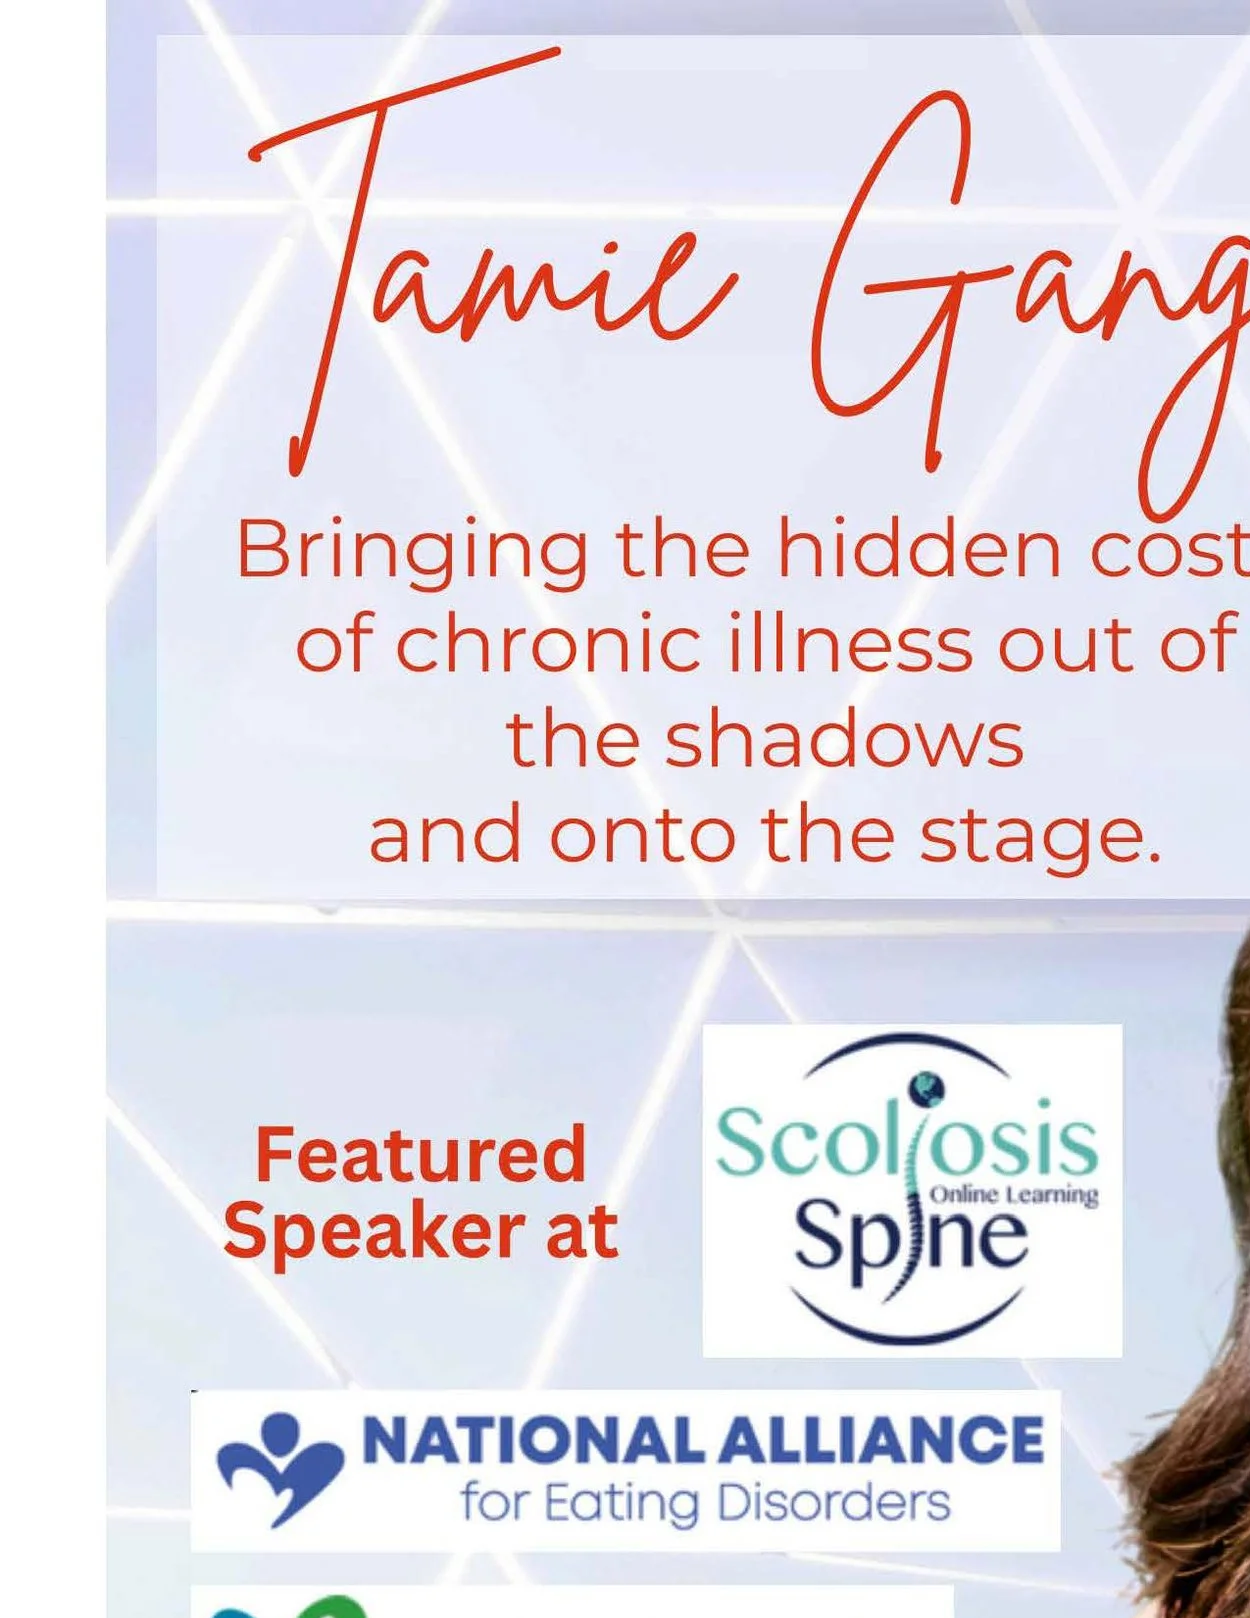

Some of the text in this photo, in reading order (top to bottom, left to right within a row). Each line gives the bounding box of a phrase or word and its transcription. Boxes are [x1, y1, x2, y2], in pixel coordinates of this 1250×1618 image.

[248, 47, 739, 477] Tamie
[240, 515, 586, 593] Bringing
[616, 516, 749, 577] the
[781, 516, 1059, 577] hidden
[297, 610, 1238, 672] of chronic illness out of
[506, 706, 1023, 768] the shadows
[371, 801, 1159, 878] and onto the stage.
[258, 1123, 584, 1183] Featured
[716, 1073, 1100, 1180] Scoliosis
[929, 1184, 1099, 1209] Online Learning
[225, 1197, 618, 1275] Speaker at
[795, 1196, 1029, 1302] Spine
[363, 1414, 1044, 1465] NATIONAL ALLIANCE
[460, 1479, 951, 1531] for Eating Disorders
